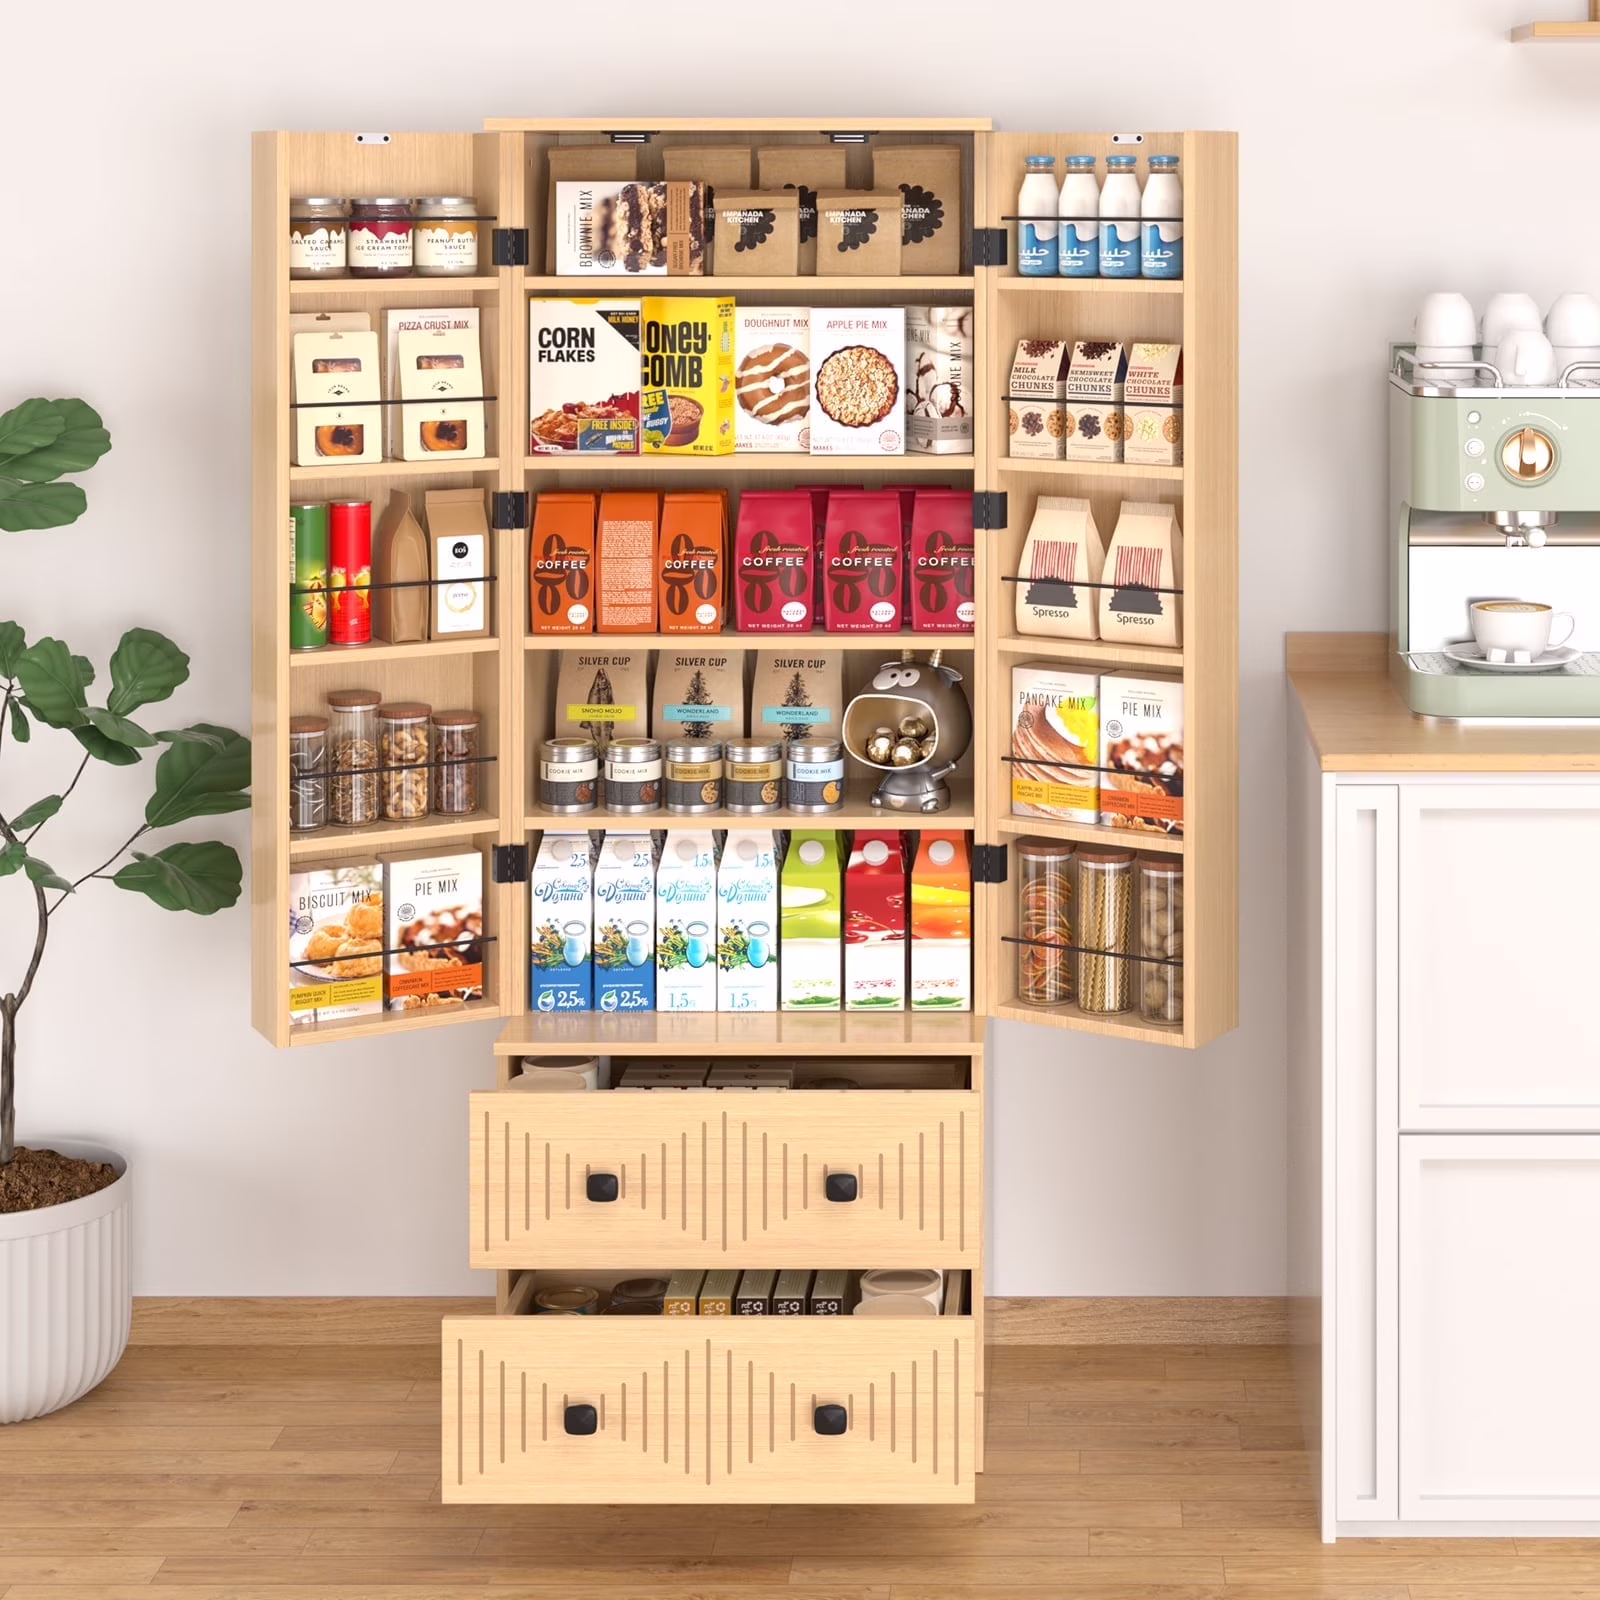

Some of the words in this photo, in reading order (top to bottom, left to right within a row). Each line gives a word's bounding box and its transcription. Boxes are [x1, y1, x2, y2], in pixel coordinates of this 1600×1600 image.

[580, 190, 592, 210] MIX
[580, 216, 592, 268] BROWNIE
[399, 321, 422, 330] PIZZA
[424, 321, 451, 329] CRUST
[454, 320, 469, 329] MIX
[745, 319, 790, 328] DOUGHNUT
[794, 319, 809, 328] MIX
[827, 320, 853, 329] APPLE
[856, 320, 869, 329] PIE
[872, 320, 887, 329] MIX
[538, 327, 595, 348] CORN
[538, 350, 595, 362] FLAKES
[950, 342, 961, 360] MIX
[1011, 381, 1054, 390] CHUNKS
[1068, 384, 1111, 392] CHUNKS
[1126, 386, 1170, 395] CHUNKS
[537, 560, 586, 569] COFFEE
[665, 560, 714, 568] COFFEE
[743, 557, 804, 566] COFFEE
[832, 557, 893, 566] COFFEE
[1032, 606, 1069, 618] Spresso
[1116, 613, 1155, 625] Spresso
[578, 656, 609, 665] SILVER
[612, 656, 631, 665] CUP
[676, 657, 706, 666] SILVER
[709, 658, 727, 666] CUP
[774, 659, 804, 668] SILVER
[808, 659, 826, 668] CUP
[1020, 692, 1063, 709] PANCAKE
[1068, 698, 1086, 710] MIX
[1122, 702, 1138, 716] PIE
[1144, 704, 1162, 718] MIX
[415, 882, 432, 896] PIE
[439, 879, 458, 894] MIX
[535, 882, 584, 904] Долина
[597, 882, 646, 904] Долина
[299, 892, 345, 911] BISCUIT
[352, 889, 372, 904] MIX
